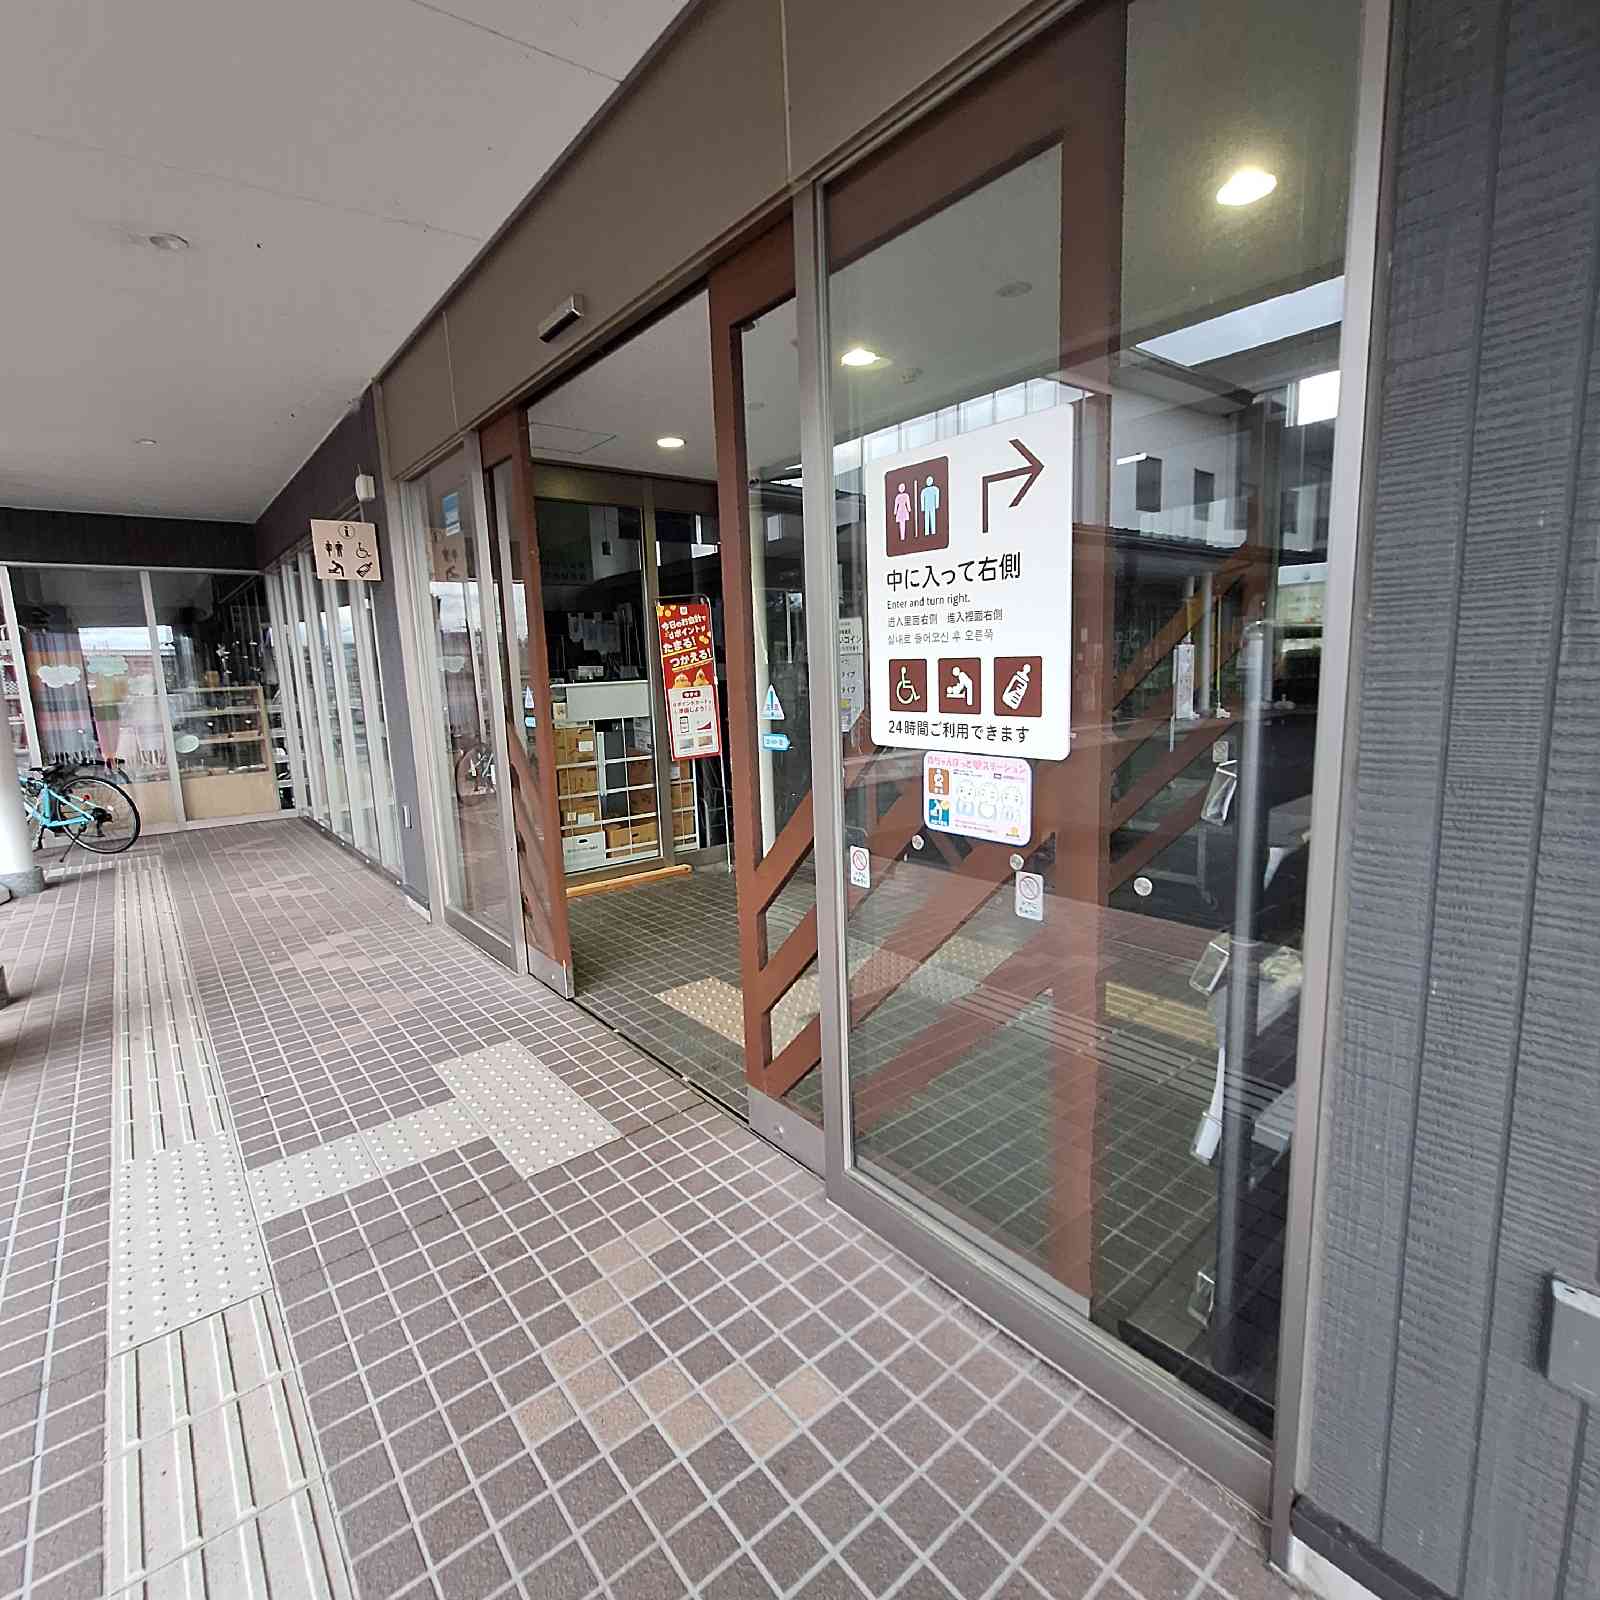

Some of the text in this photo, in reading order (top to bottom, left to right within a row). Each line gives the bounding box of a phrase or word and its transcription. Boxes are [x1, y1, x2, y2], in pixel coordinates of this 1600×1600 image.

[887, 551, 1021, 592] 中に入って右側
[887, 593, 971, 610] Enter and turn right.
[888, 719, 1030, 743] 24時間ご利用できます
